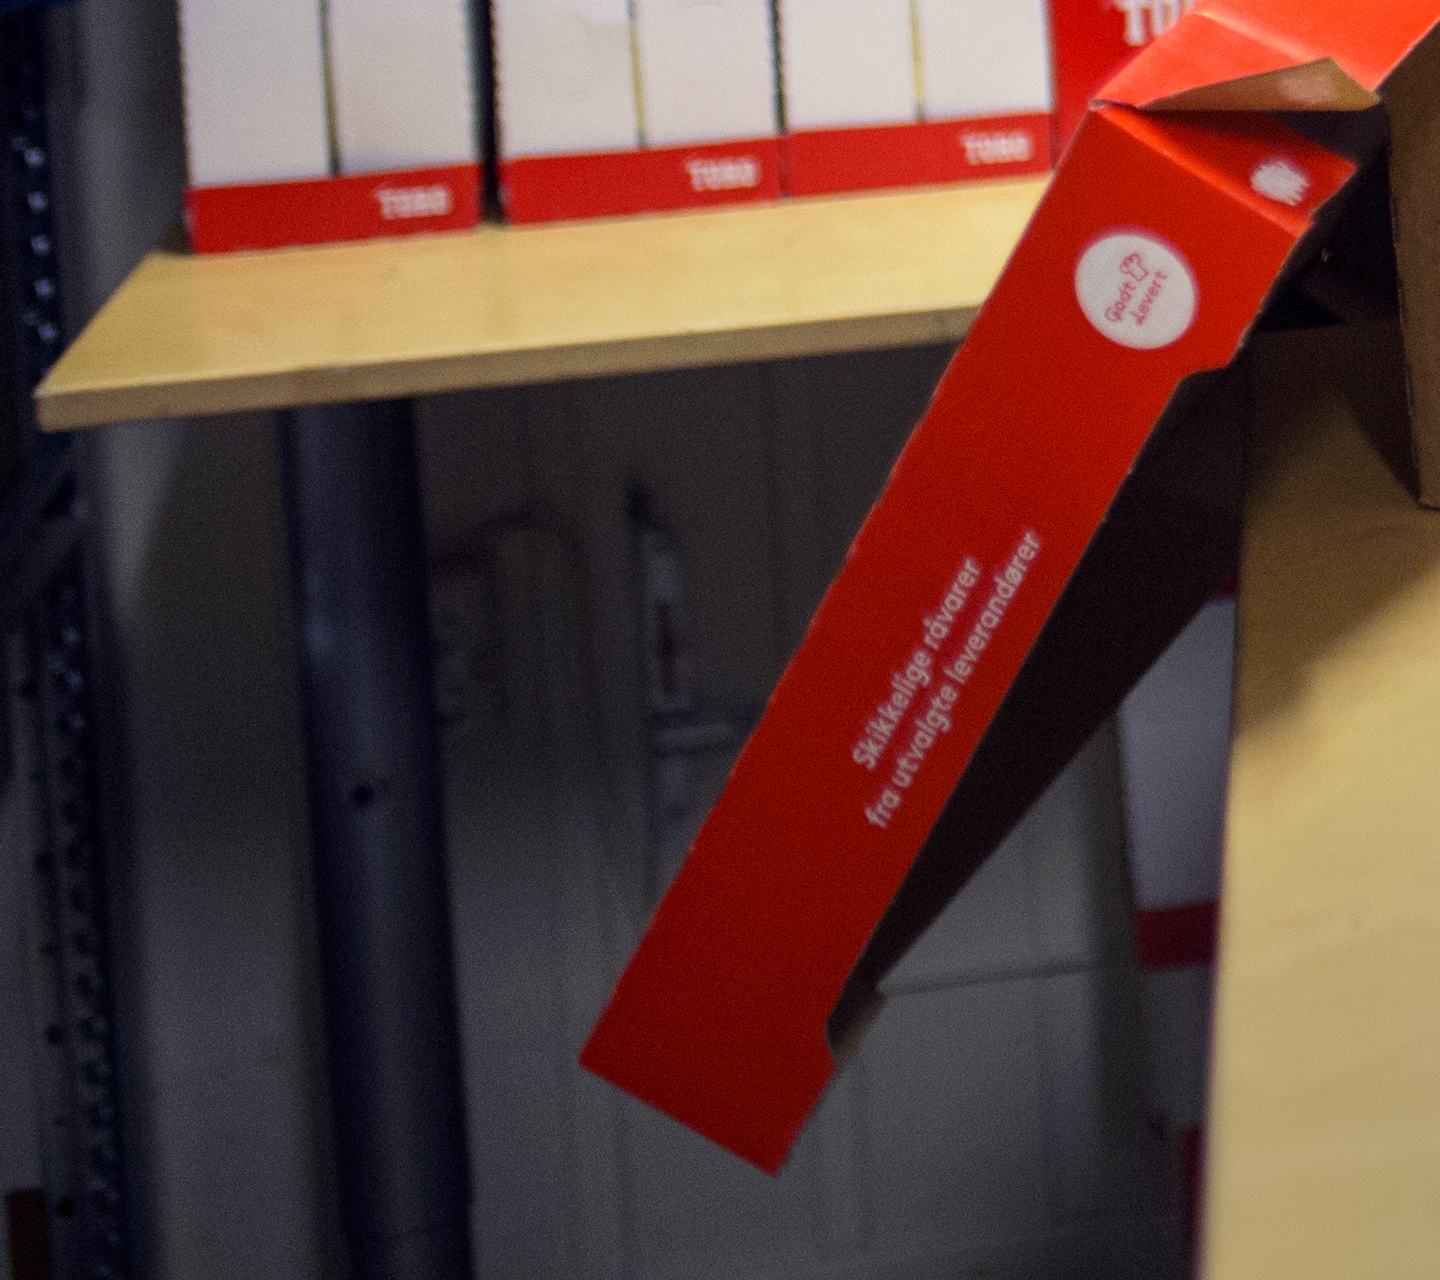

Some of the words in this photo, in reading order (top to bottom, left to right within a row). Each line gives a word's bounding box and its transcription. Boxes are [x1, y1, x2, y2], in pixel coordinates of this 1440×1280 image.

[852, 650, 931, 771] Skikkelige
[923, 556, 981, 650] råvarer
[865, 788, 901, 829] fra
[892, 685, 957, 788] utvalgte
[944, 532, 1041, 684] leverandører
